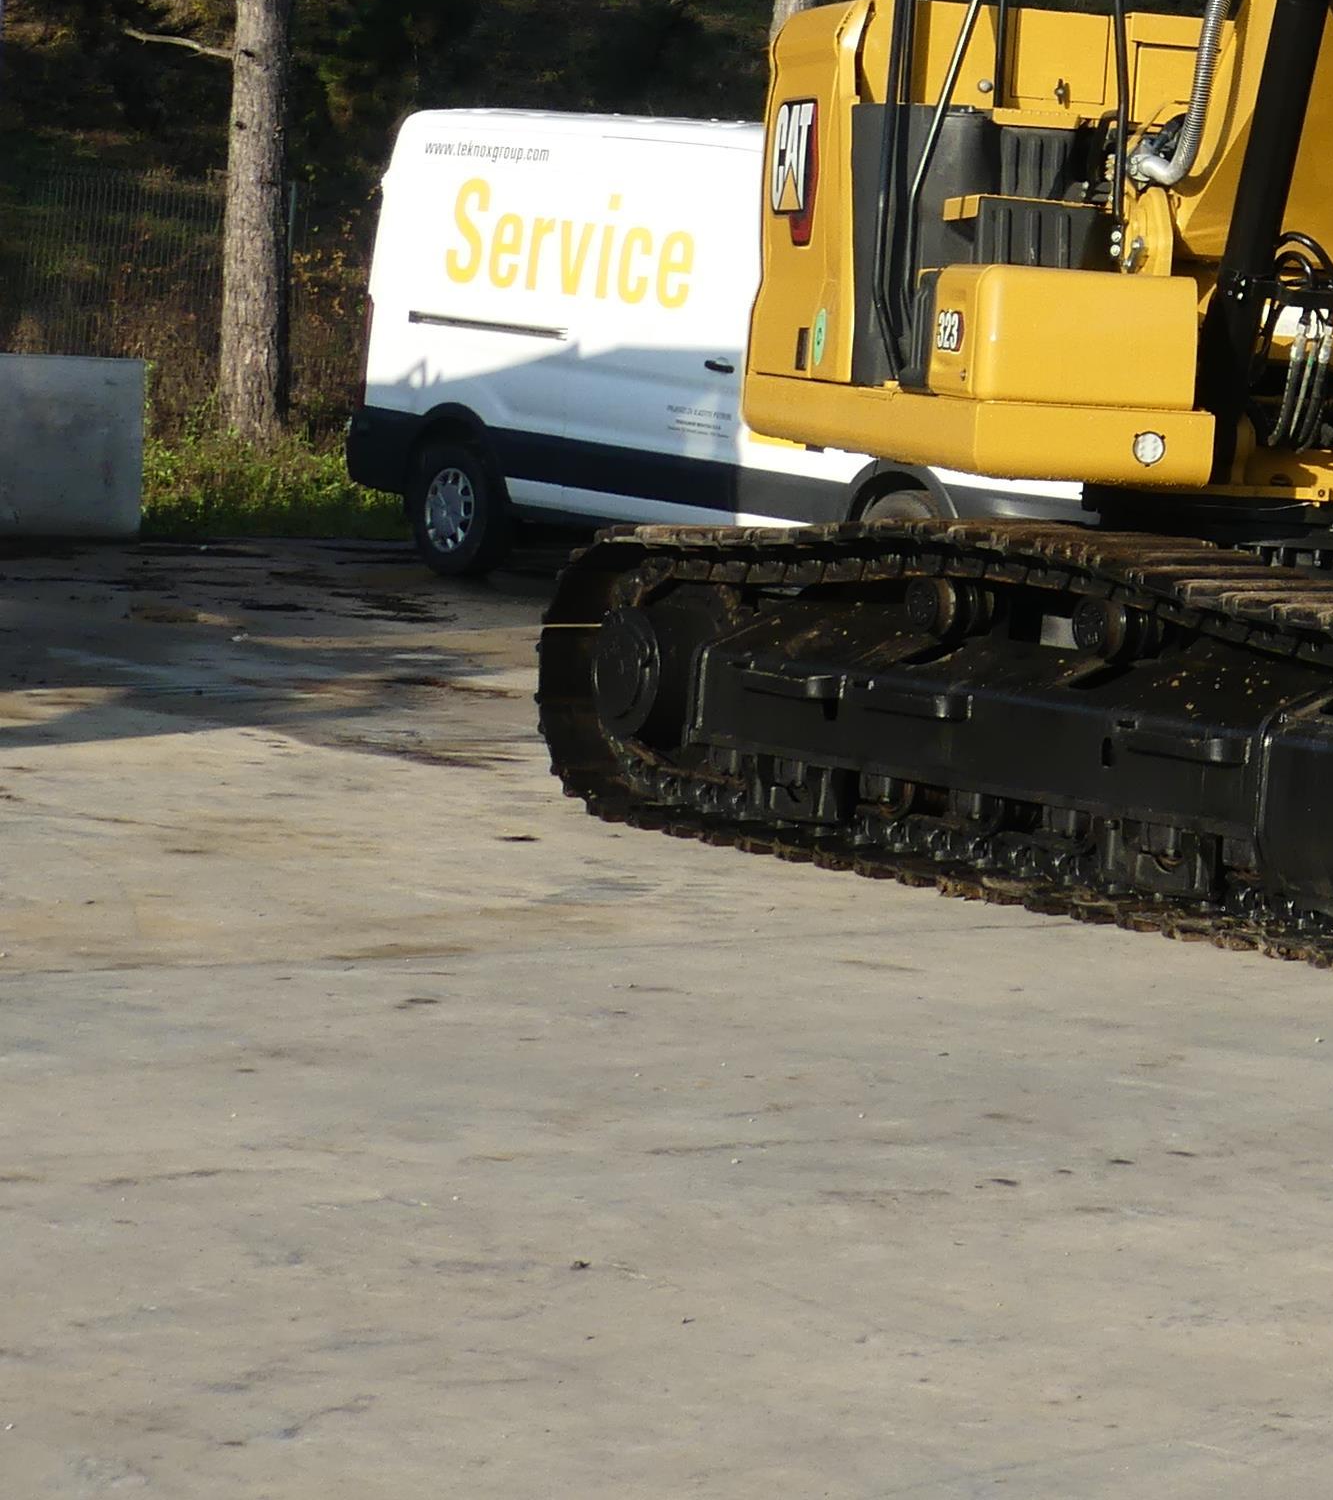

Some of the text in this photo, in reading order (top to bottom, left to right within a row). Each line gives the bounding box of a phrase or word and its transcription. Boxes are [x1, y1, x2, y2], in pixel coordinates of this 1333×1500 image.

[425, 141, 550, 163] www.teknoxgroup.com
[772, 103, 815, 211] CAT
[446, 178, 695, 309] Service
[937, 311, 959, 349] 323
